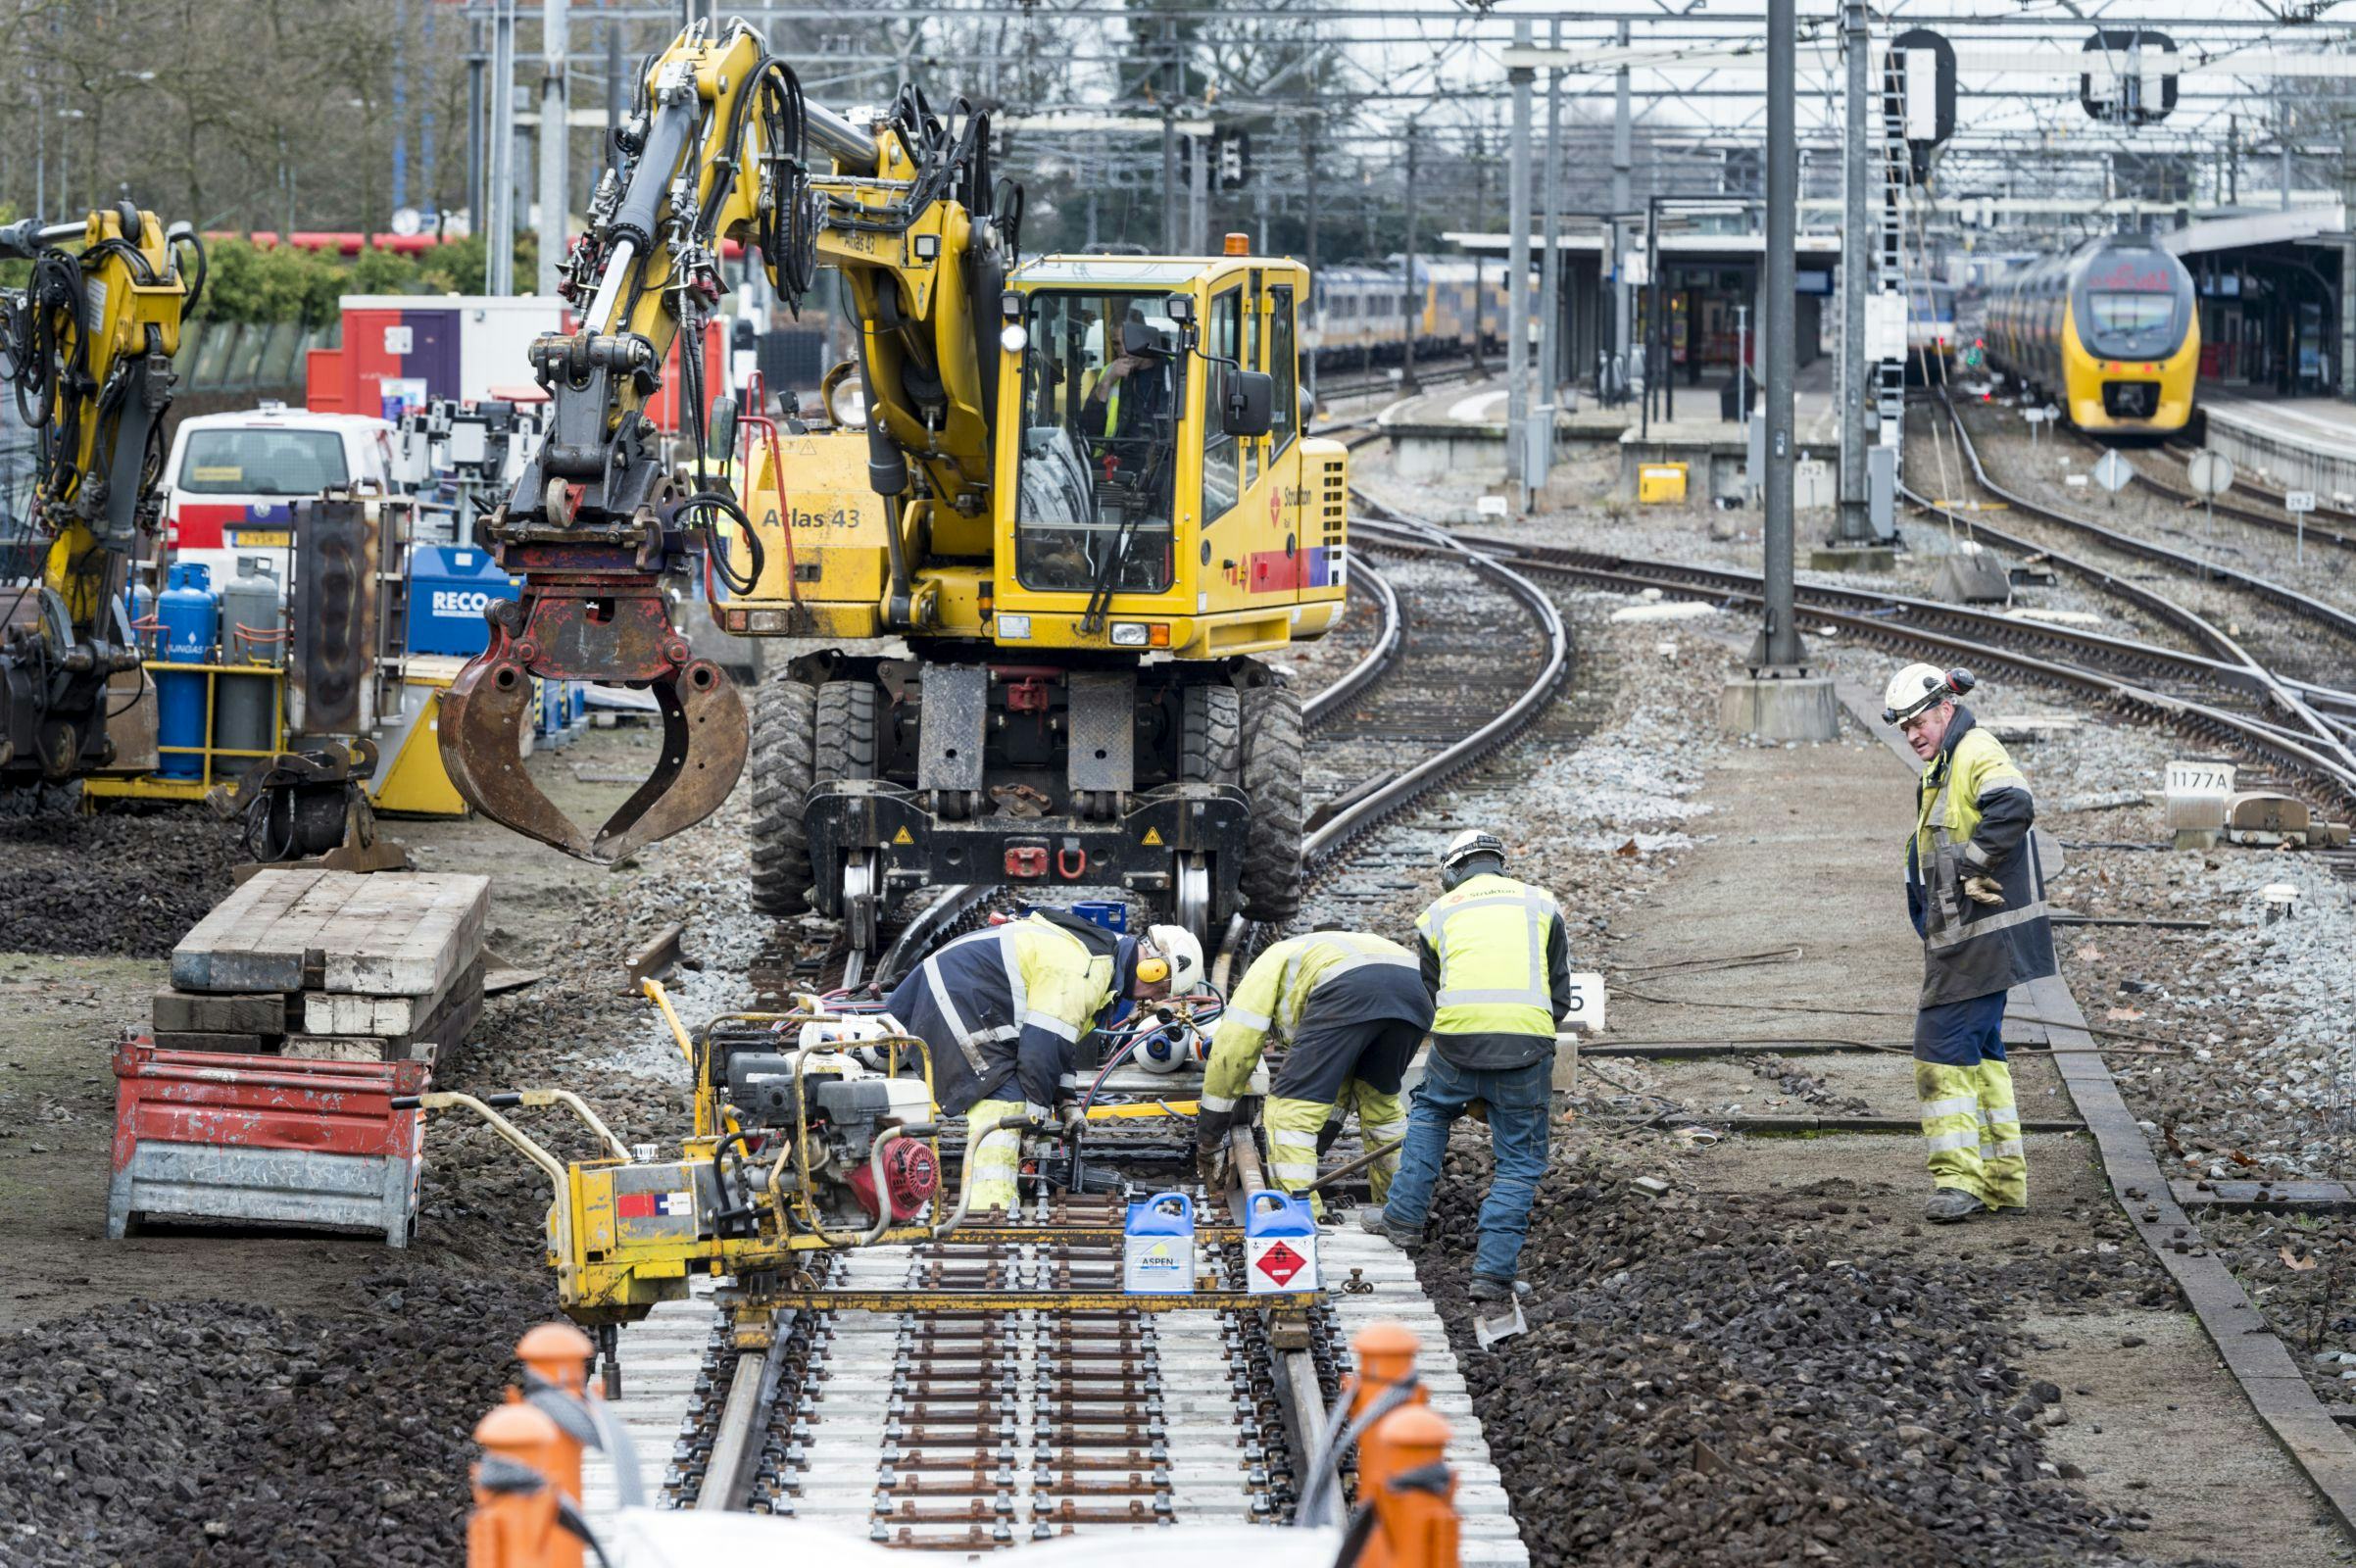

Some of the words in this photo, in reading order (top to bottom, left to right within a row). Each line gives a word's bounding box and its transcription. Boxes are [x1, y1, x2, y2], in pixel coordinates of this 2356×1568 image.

[865, 234, 875, 255] 43
[831, 509, 860, 528] 43
[432, 591, 489, 612] RECO
[2173, 772, 2228, 789] 1177A
[1142, 1257, 1174, 1266] ASPEN
